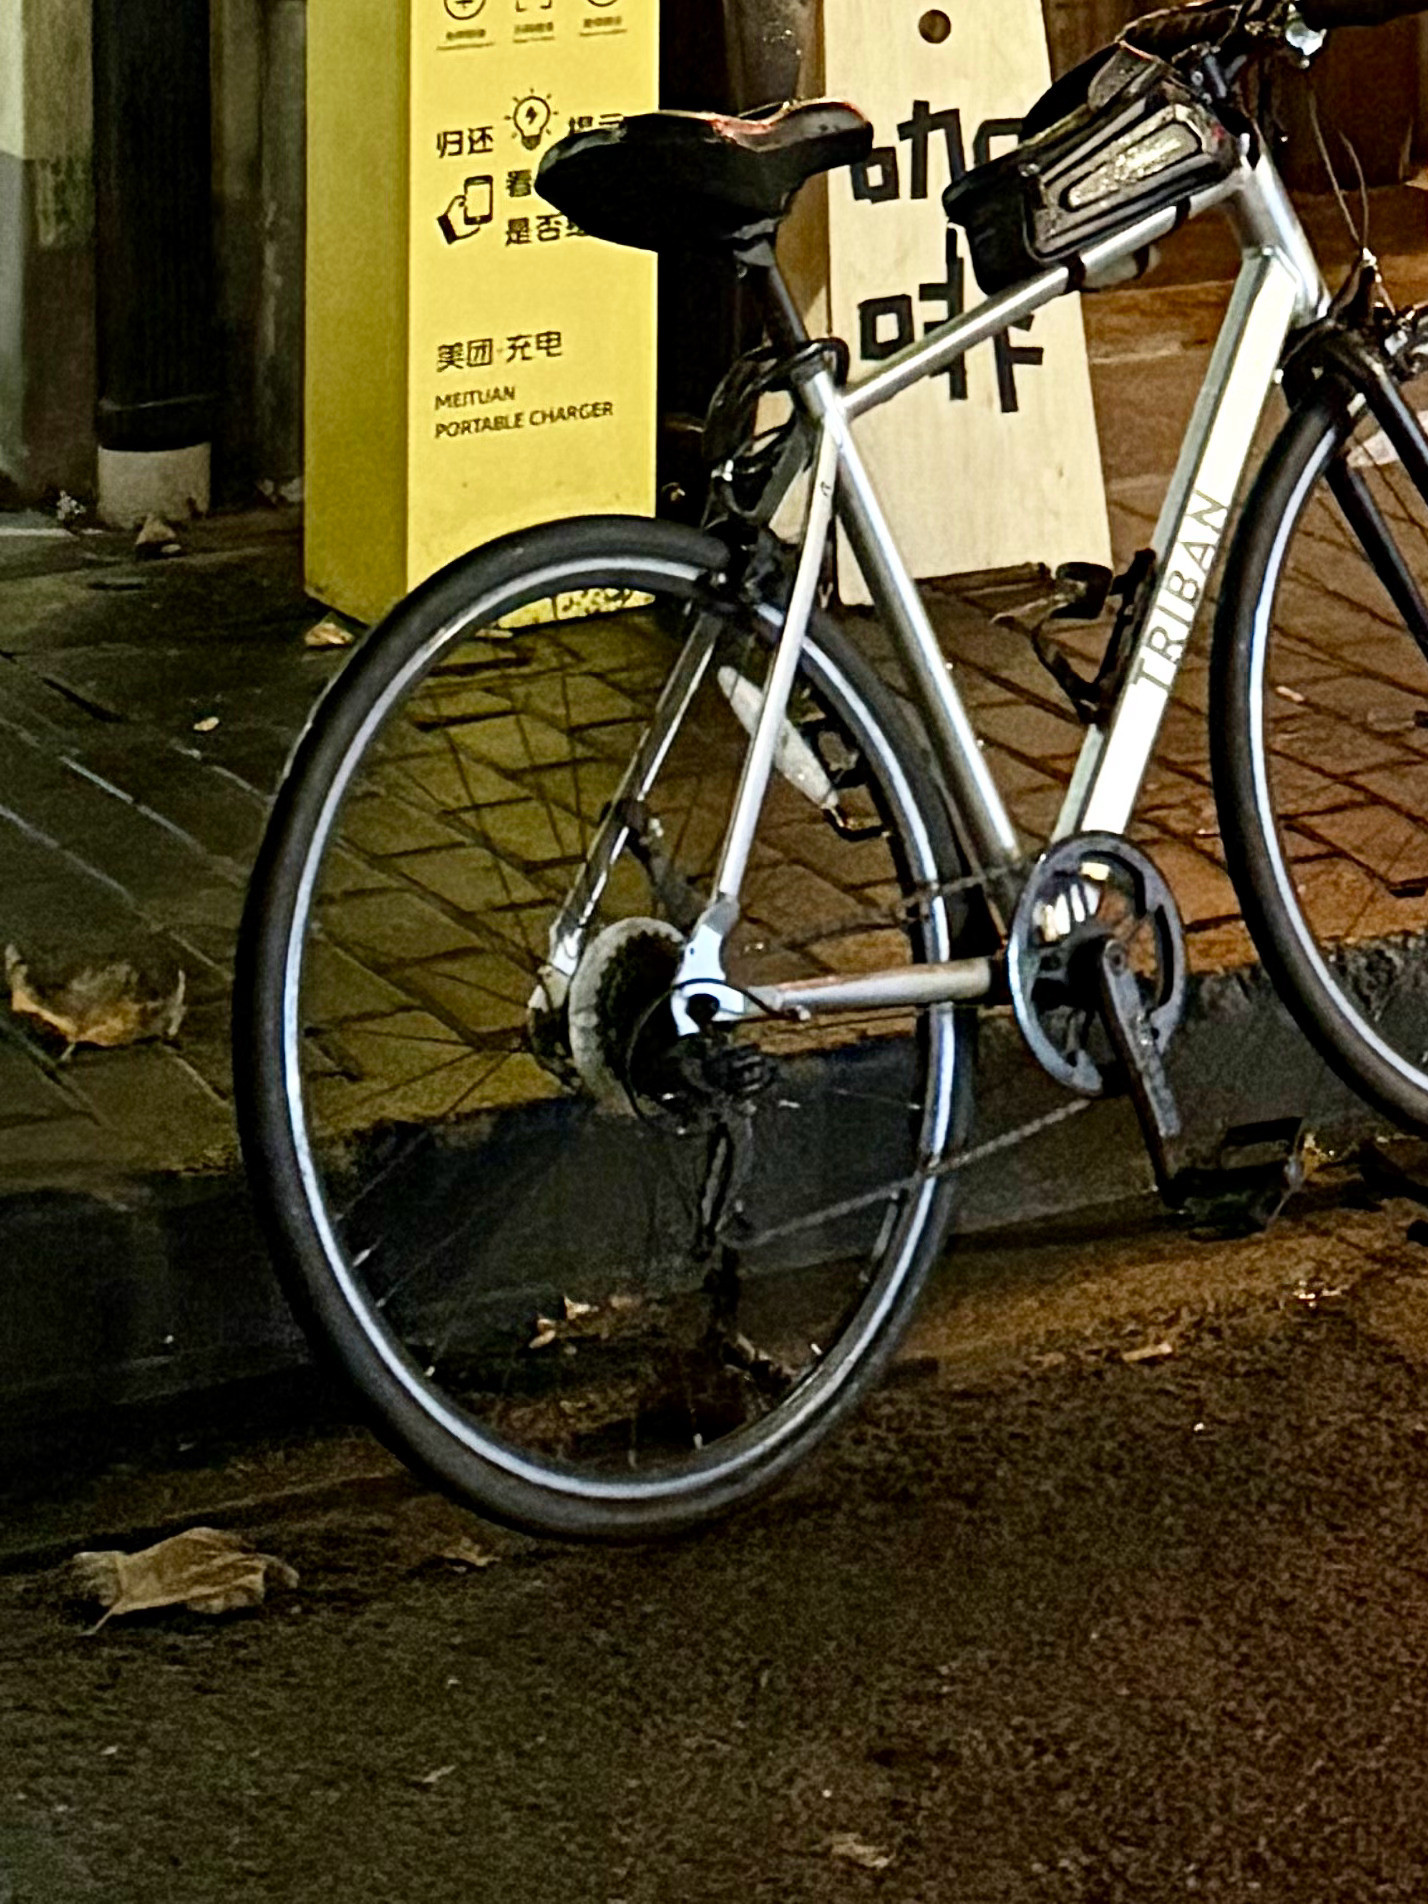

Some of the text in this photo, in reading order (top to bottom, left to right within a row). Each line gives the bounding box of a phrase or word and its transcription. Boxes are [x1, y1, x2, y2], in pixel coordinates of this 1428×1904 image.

[436, 125, 494, 158] 归还
[504, 210, 590, 248] 是否
[434, 385, 517, 412] MEITUAN
[434, 401, 614, 439] PORTABLE CHARGER
[1127, 488, 1229, 693] TRIBAN
